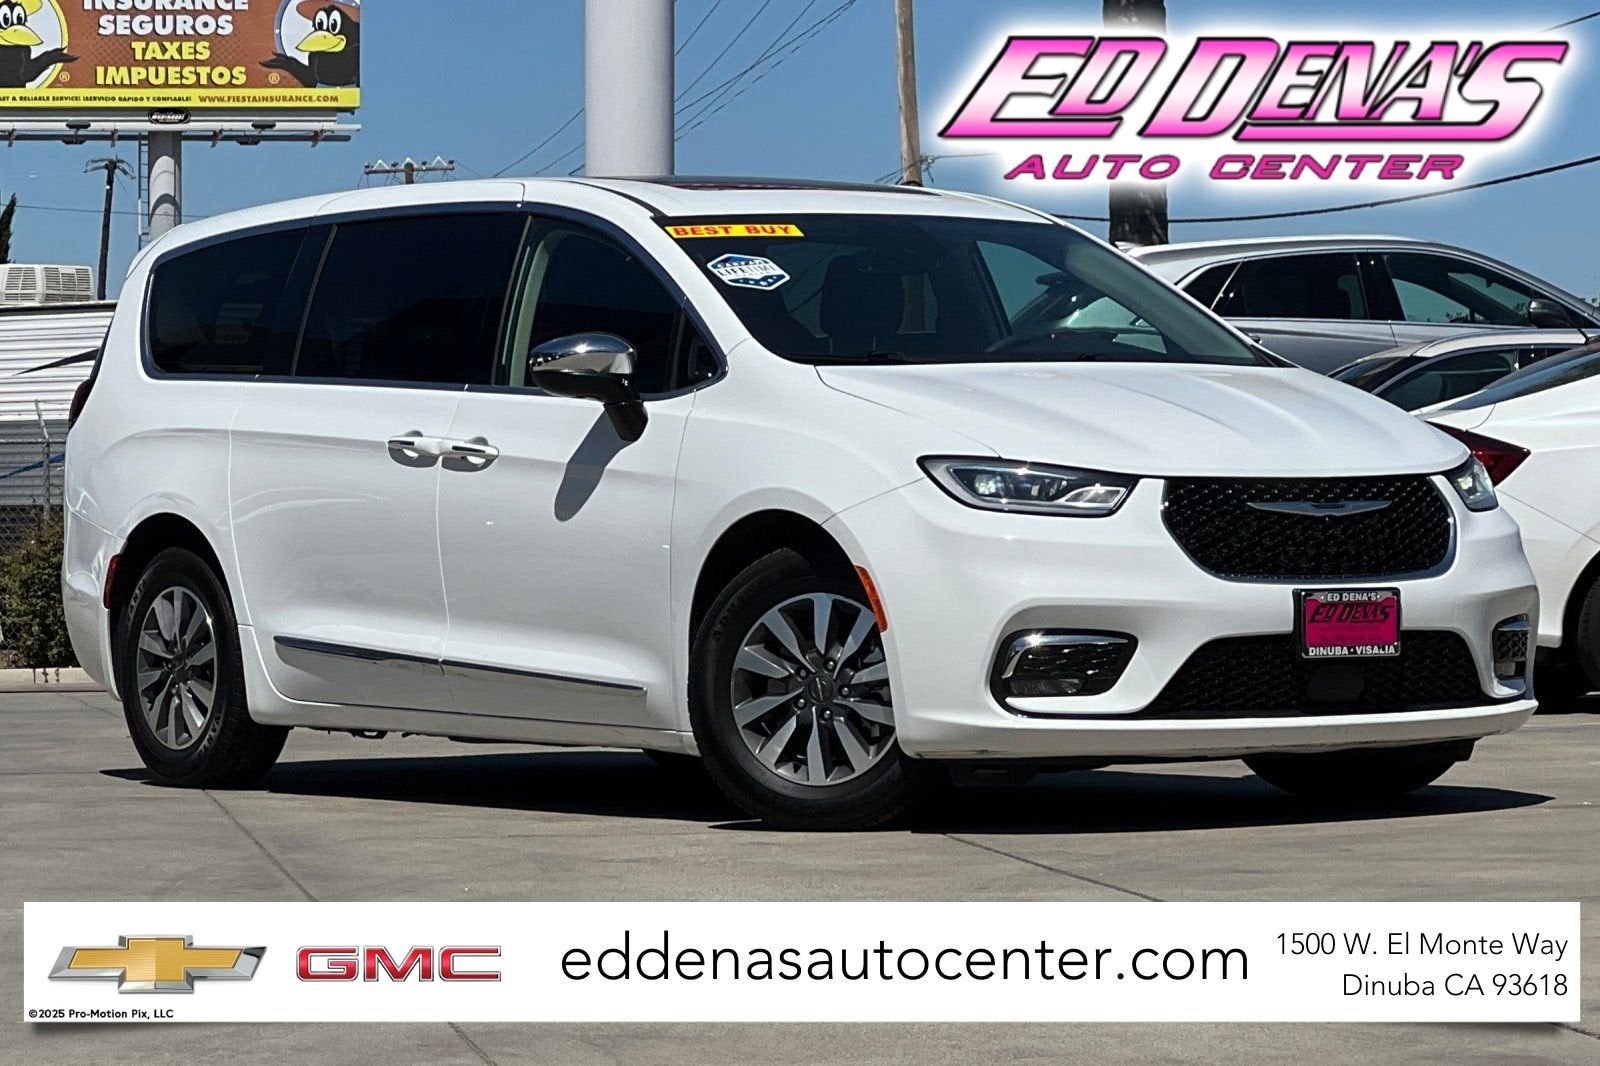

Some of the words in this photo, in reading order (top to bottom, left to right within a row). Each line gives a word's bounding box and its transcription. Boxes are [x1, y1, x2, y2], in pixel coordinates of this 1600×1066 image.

[83, 0, 249, 11] INSURANCE
[98, 14, 234, 36] SEGUROS
[131, 41, 211, 61] TAXES
[96, 66, 247, 86] IMPUESTOS
[197, 94, 339, 103] WWW.FIESTAINSURANCE.COM
[672, 226, 732, 236] BEST
[744, 225, 791, 235] BUY
[1327, 592, 1340, 602] ED
[1342, 592, 1377, 601] DENA'S
[1308, 646, 1349, 656] DINUBA
[1355, 645, 1396, 655] VISALIA
